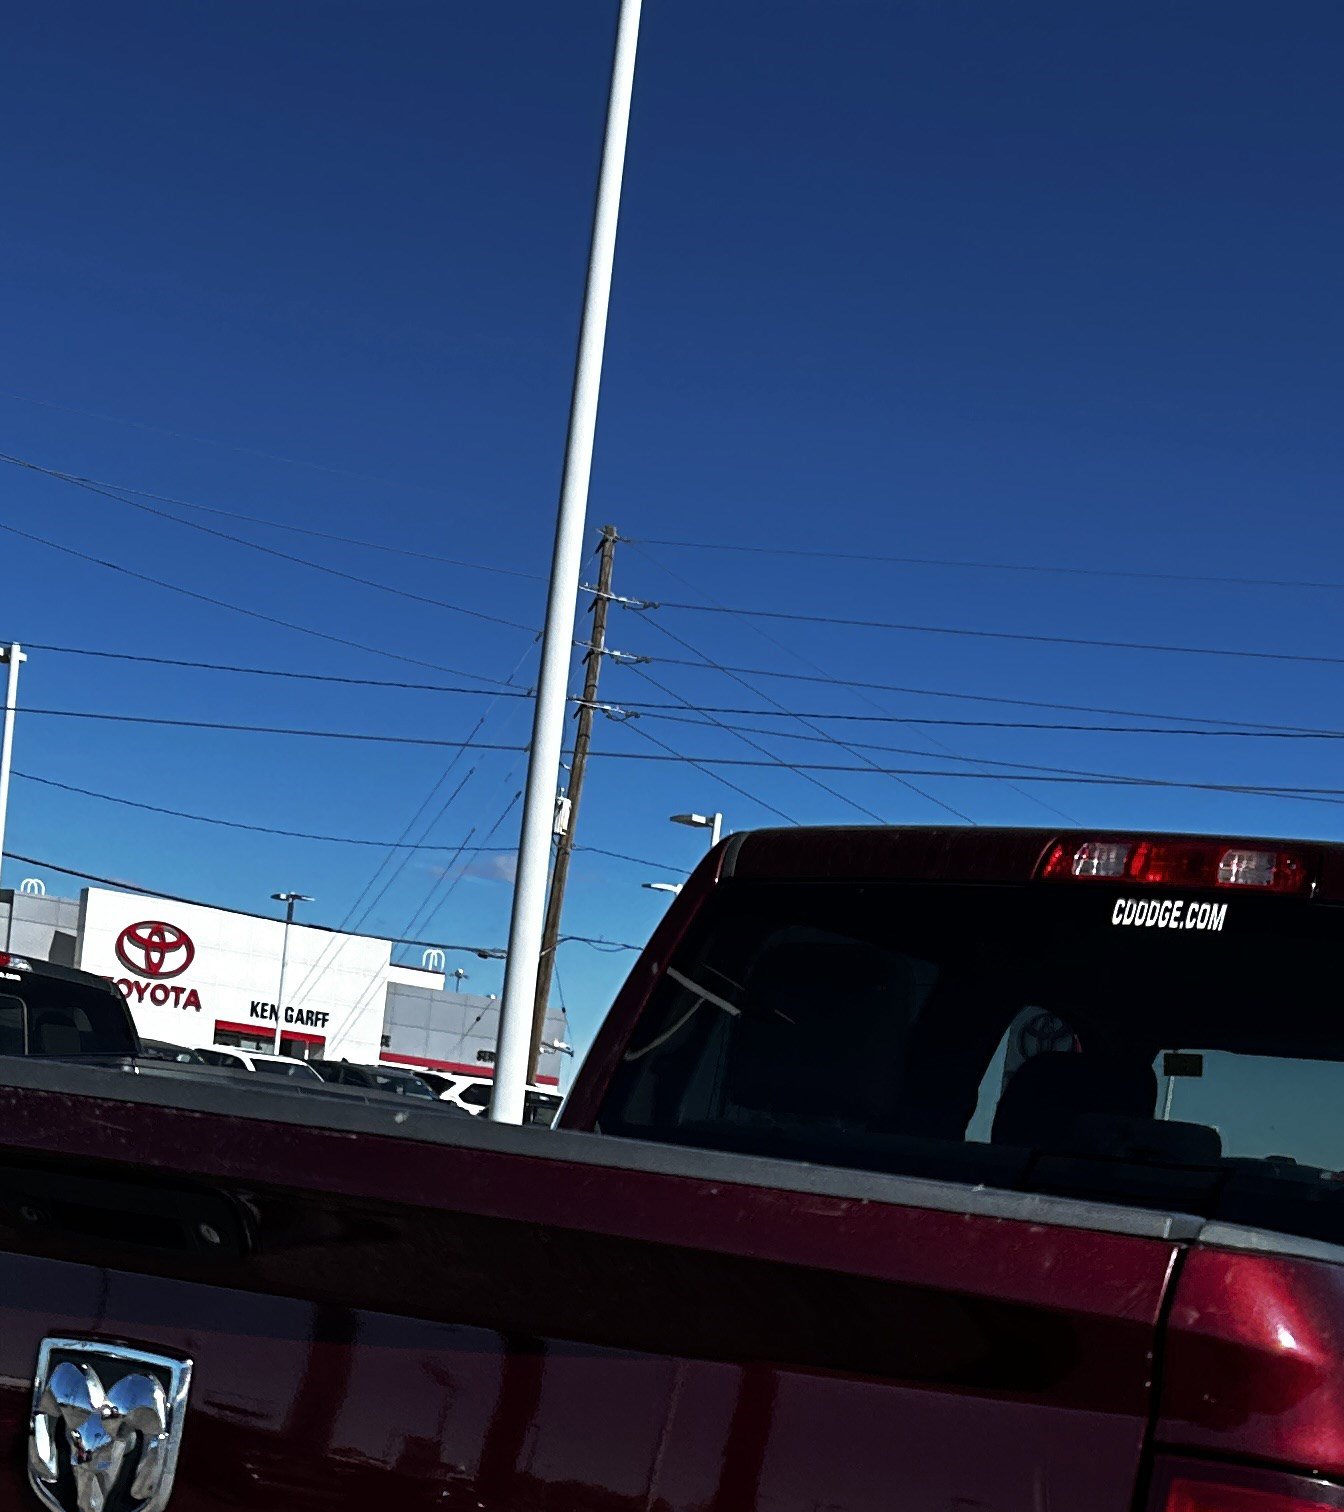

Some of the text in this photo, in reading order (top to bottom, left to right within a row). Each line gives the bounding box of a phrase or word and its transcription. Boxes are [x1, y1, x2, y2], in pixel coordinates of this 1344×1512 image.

[1112, 899, 1228, 931] CDODGE.COM
[249, 1000, 330, 1028] KEN GARFF
